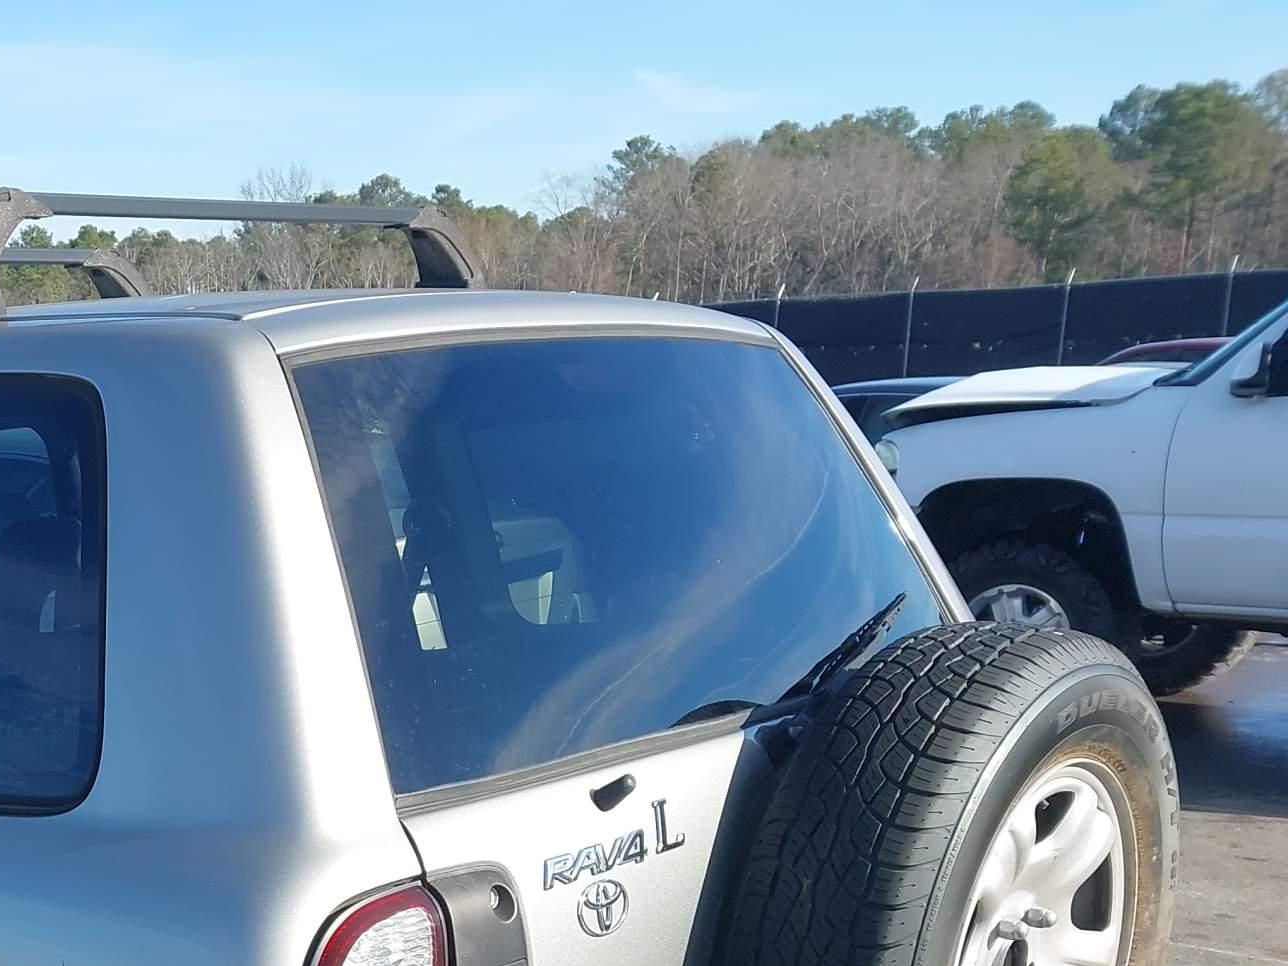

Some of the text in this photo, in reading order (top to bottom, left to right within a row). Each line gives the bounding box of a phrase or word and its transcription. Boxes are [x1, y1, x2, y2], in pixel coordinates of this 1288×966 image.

[1056, 688, 1161, 744] DUELER
[543, 797, 686, 891] RAV4 L
